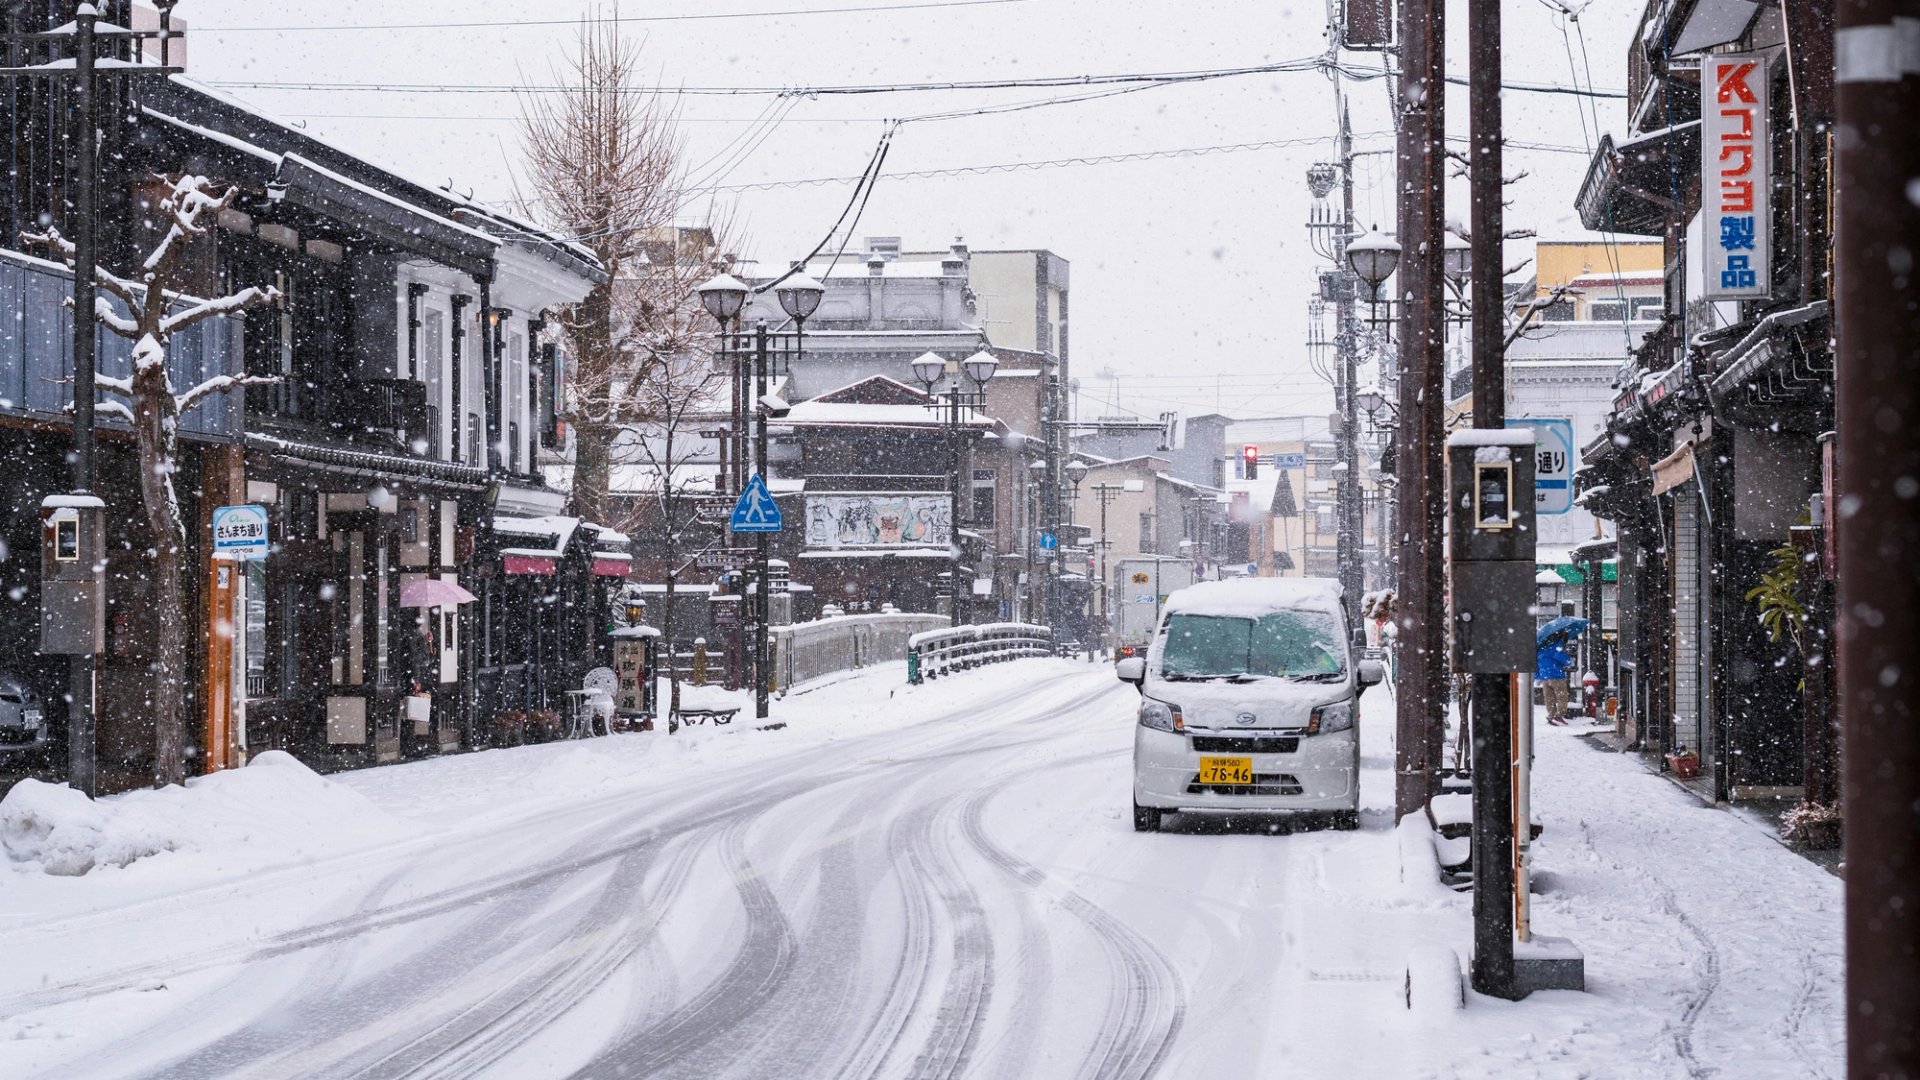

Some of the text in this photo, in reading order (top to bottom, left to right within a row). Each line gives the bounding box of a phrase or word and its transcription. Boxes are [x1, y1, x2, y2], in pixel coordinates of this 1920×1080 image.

[1534, 451, 1565, 474] 通り
[217, 523, 263, 539] さんまち通り
